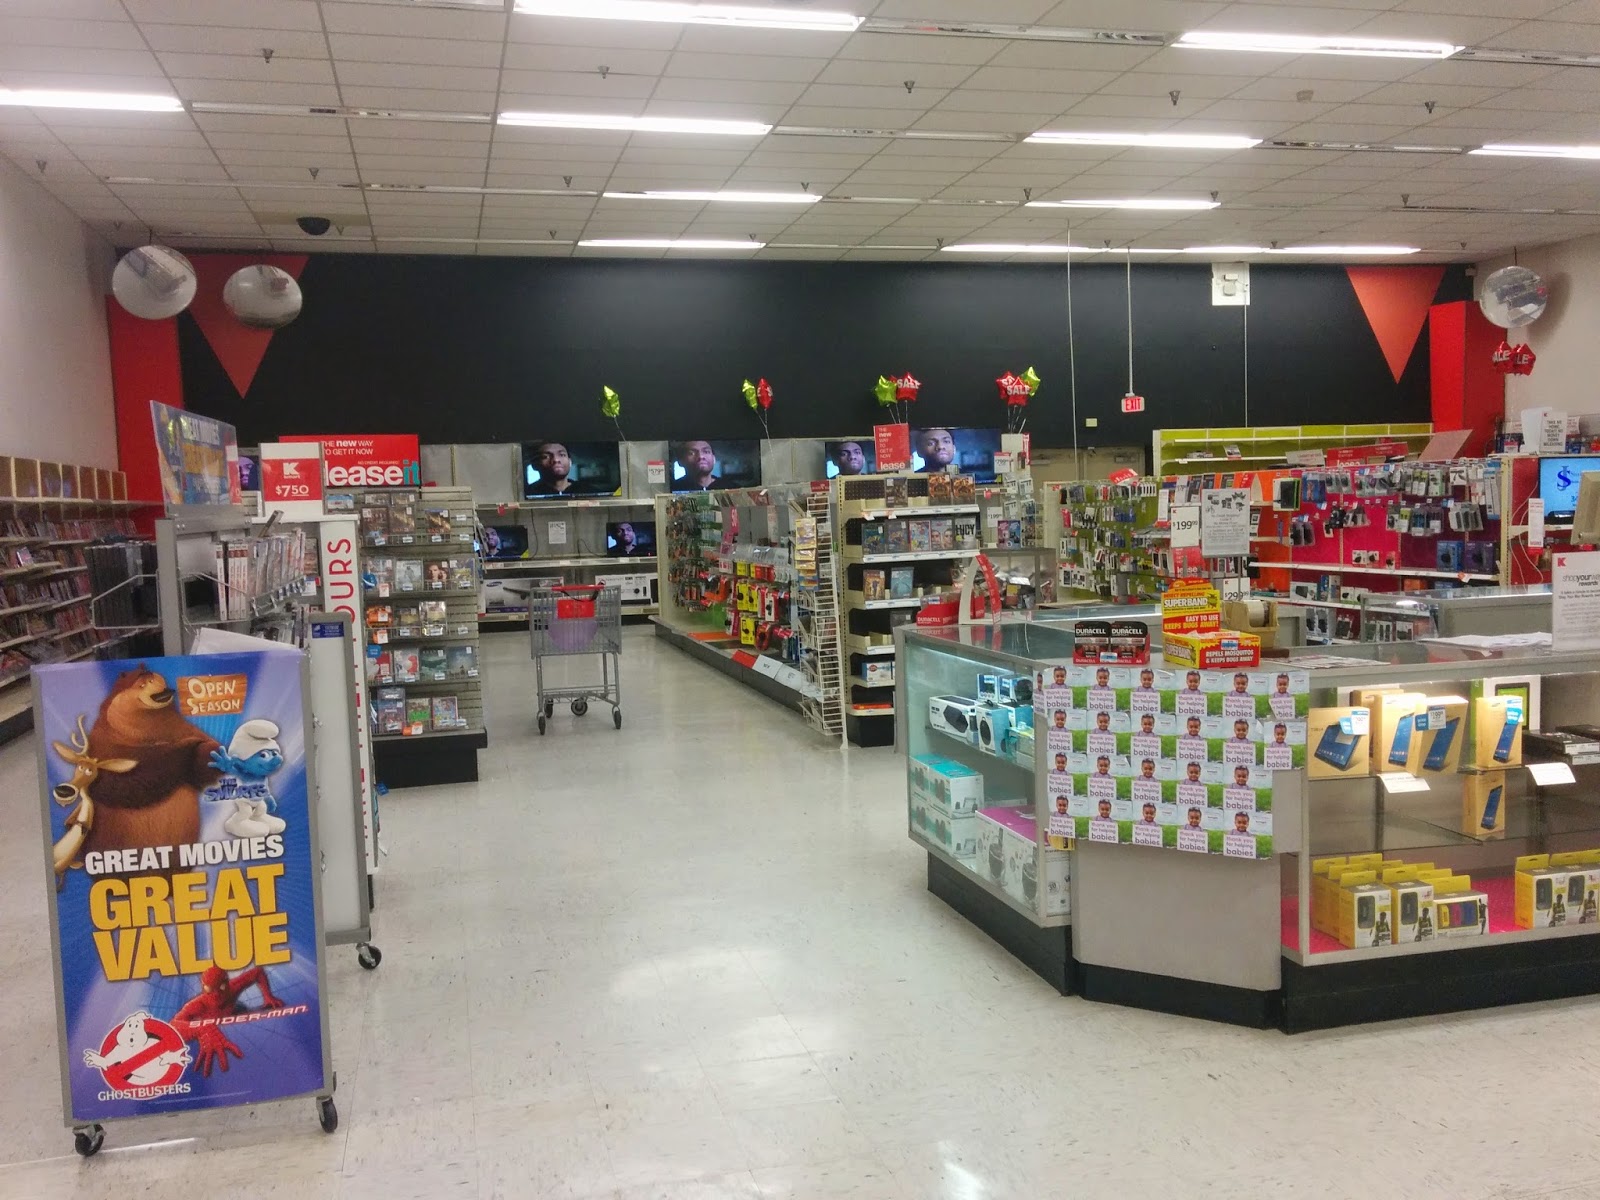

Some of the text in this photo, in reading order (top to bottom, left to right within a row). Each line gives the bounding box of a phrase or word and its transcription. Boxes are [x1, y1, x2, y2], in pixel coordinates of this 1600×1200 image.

[1492, 350, 1510, 362] ALE
[1516, 354, 1529, 364] LE
[898, 379, 920, 389] SALE
[1007, 386, 1030, 395] SALE
[1126, 399, 1140, 410] EXIT
[881, 461, 905, 470] lease
[955, 524, 975, 537] LUCY
[1177, 566, 1197, 574] lese
[187, 677, 236, 698] OPEN
[186, 697, 240, 716] SEASON
[1133, 704, 1158, 712] babies
[1226, 709, 1252, 717] babies
[1179, 752, 1205, 760] babies
[1226, 756, 1253, 764] babies
[219, 778, 237, 786] THE
[204, 784, 269, 801] SMURFS
[1134, 793, 1159, 801] babies
[1226, 802, 1253, 810] babies
[1092, 833, 1116, 841] babies
[1135, 837, 1160, 845] babies
[1180, 843, 1205, 851] babies
[85, 836, 284, 875] GREAT MOVIES
[1227, 848, 1253, 857] babies
[89, 864, 284, 930] GREAT
[93, 912, 290, 982] VALUE
[189, 1006, 306, 1027] SPIDER-MAN
[98, 1082, 191, 1101] GHOSTBUSTERS
